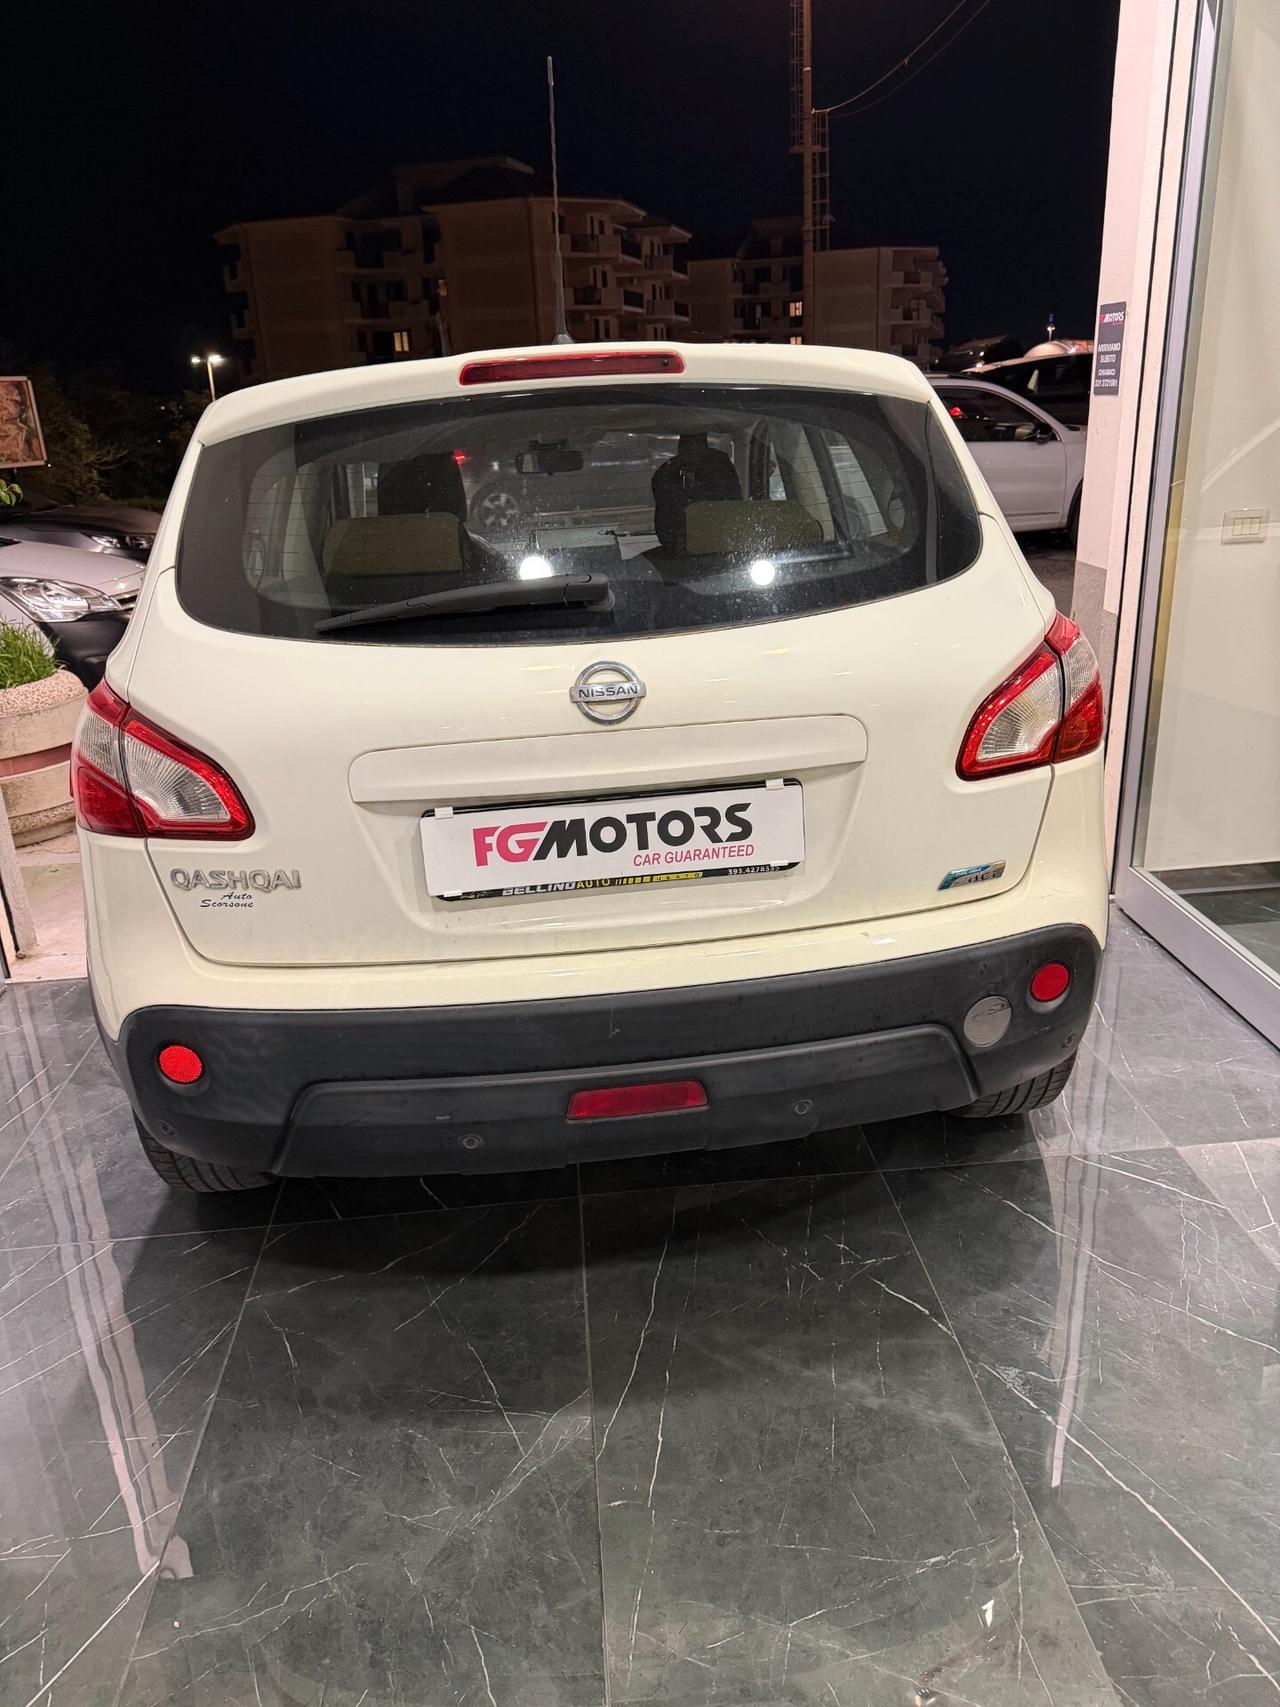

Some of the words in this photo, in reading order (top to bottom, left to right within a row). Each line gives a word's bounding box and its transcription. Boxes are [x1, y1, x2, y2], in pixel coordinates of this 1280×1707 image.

[578, 685, 638, 698] NISSAN
[633, 854, 661, 867] CAR
[664, 844, 755, 864] GUARANTEED
[170, 868, 302, 892] QASHQAI
[221, 892, 253, 900] Auto
[200, 900, 254, 908] Scorsone
